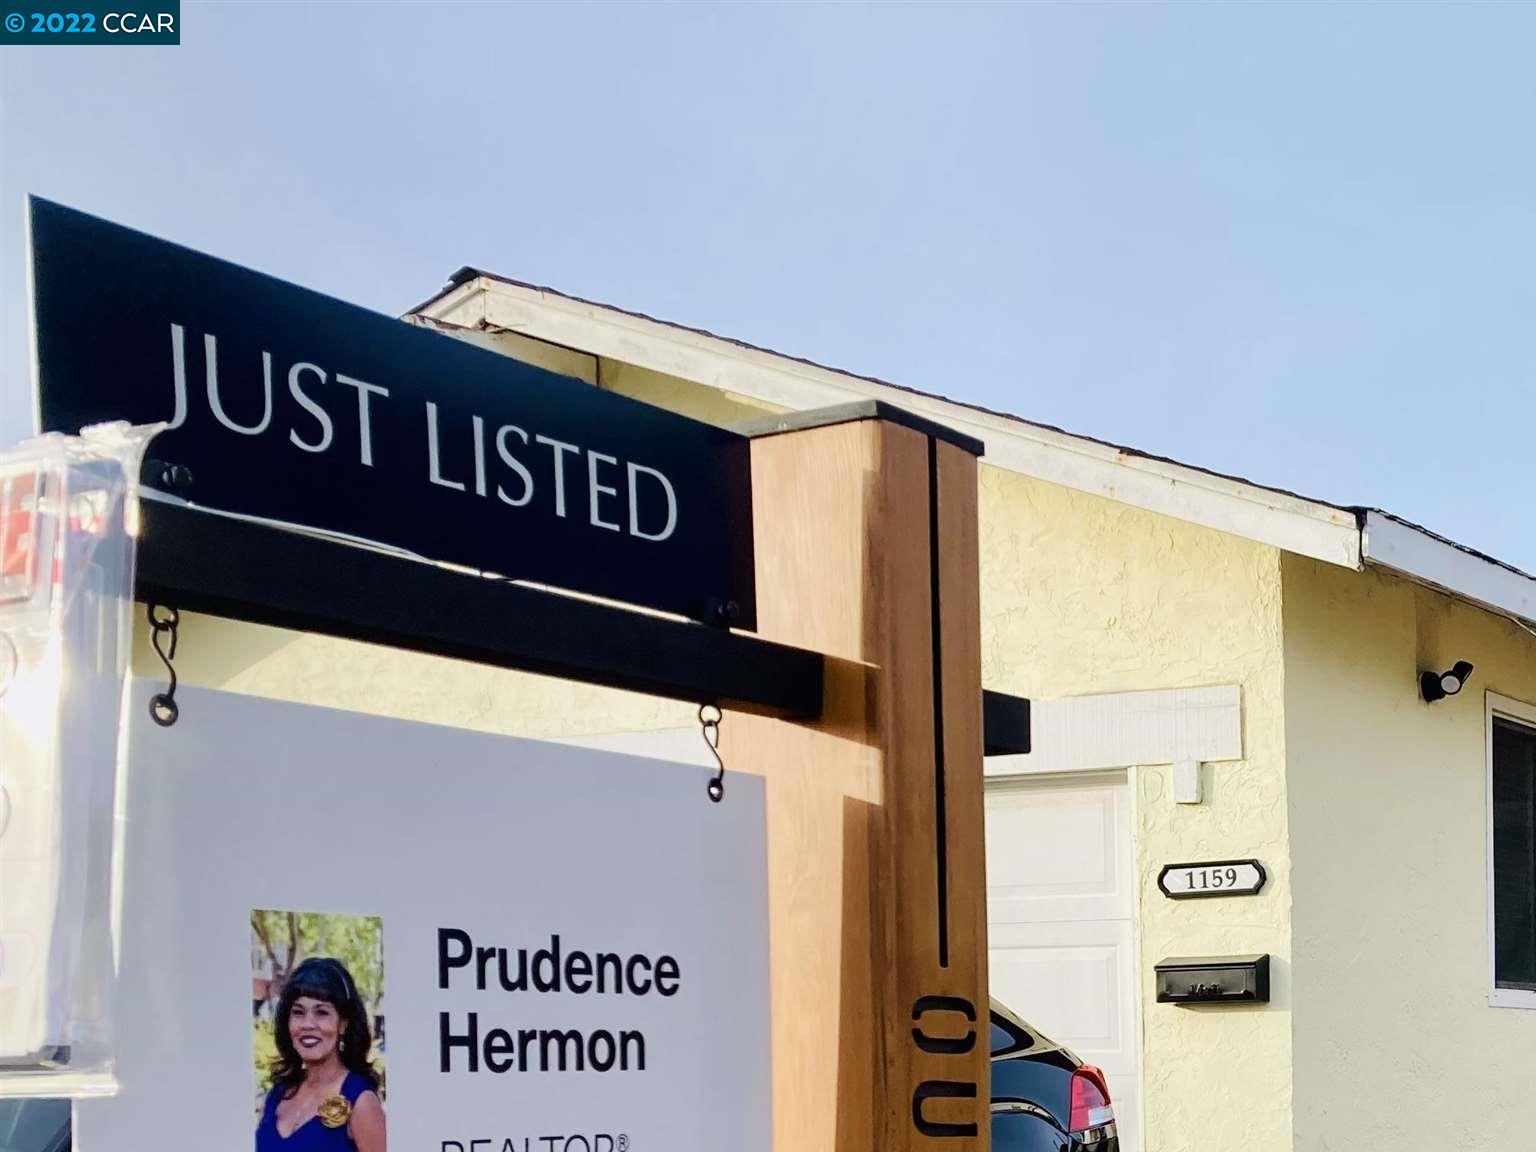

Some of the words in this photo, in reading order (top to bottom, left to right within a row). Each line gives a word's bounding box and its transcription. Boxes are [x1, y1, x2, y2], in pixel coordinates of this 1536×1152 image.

[166, 323, 390, 467] JUST
[426, 401, 678, 542] LISTED
[1185, 868, 1237, 889] 1159
[437, 927, 681, 997] Prudence
[439, 1011, 646, 1074] Hermon
